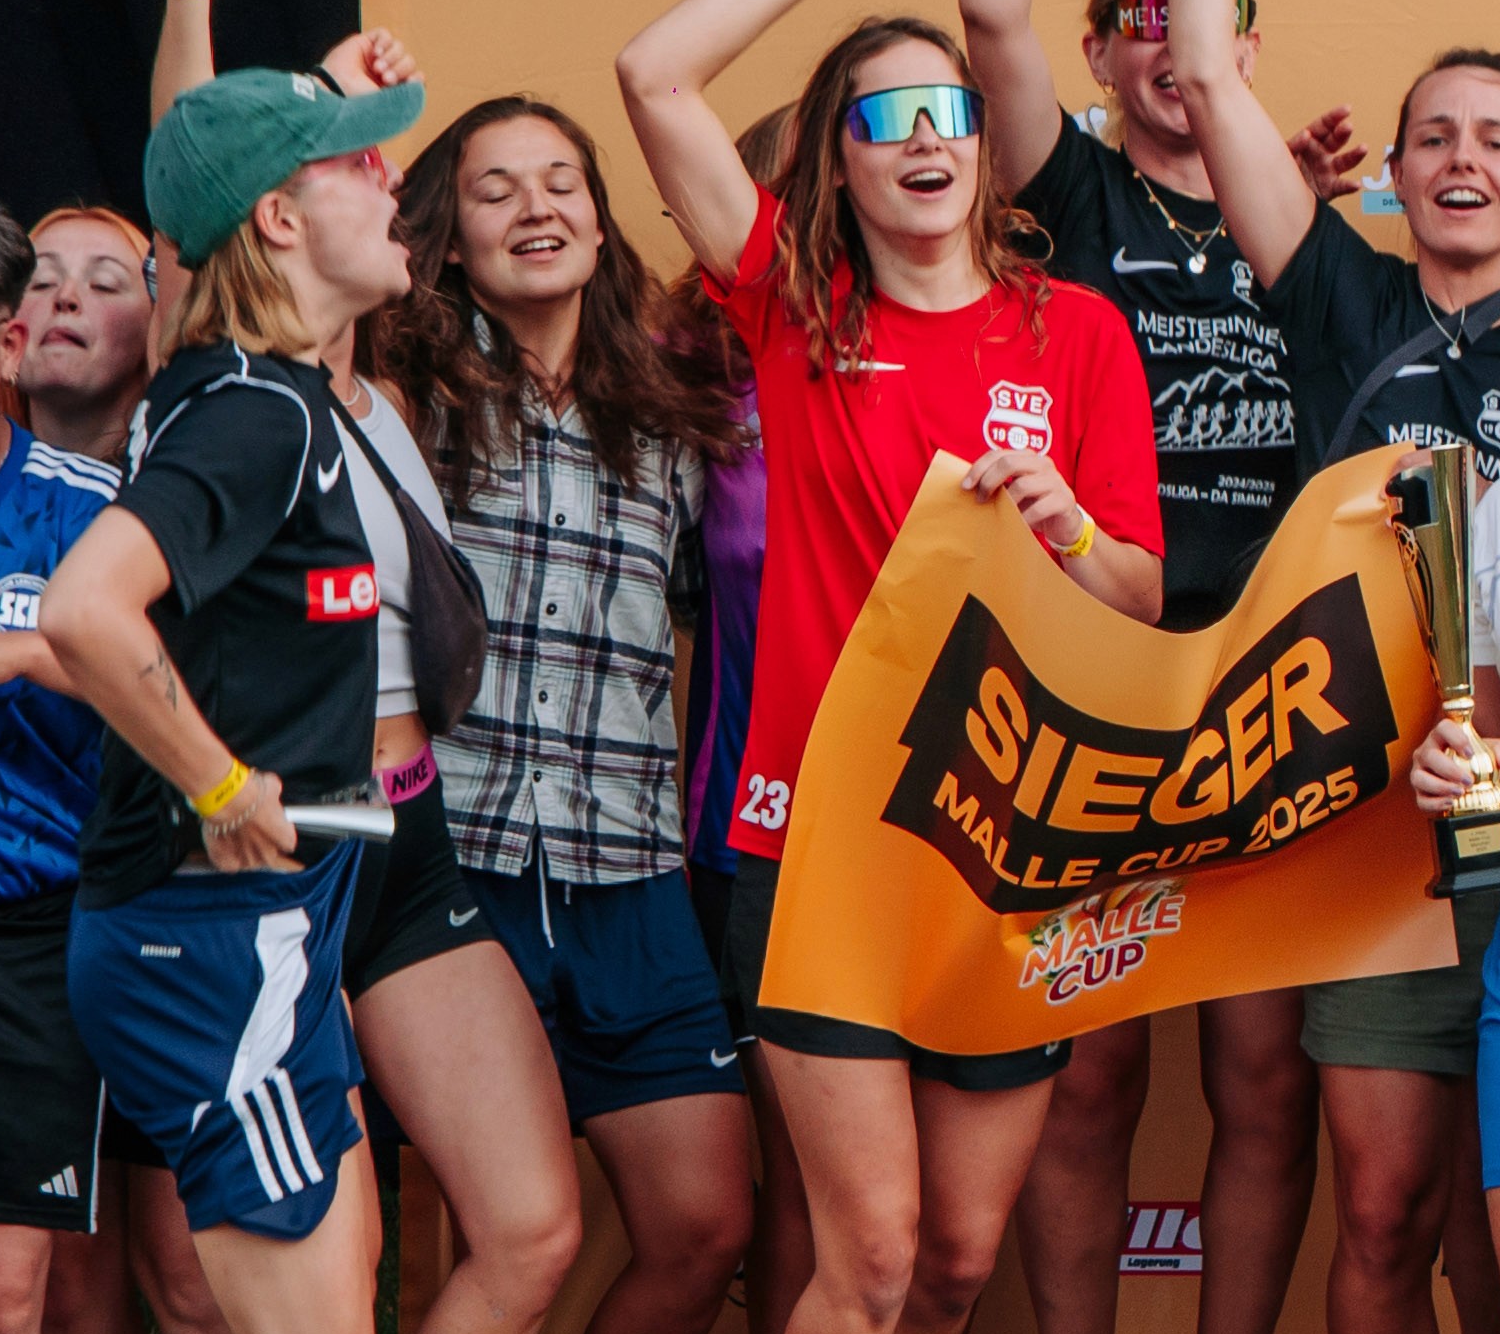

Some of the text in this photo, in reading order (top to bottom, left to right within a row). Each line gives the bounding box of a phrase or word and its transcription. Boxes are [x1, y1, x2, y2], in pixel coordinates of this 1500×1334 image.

[1148, 336, 1278, 371] LANDESLIGA
[997, 389, 1045, 412] SVE
[992, 428, 1006, 442] 19
[1211, 488, 1229, 505] DA
[965, 637, 1351, 834] SIEGER
[390, 757, 430, 796] NIKE
[739, 772, 791, 831] 23
[931, 767, 1359, 889] MALLE CUP 2025
[1019, 893, 1186, 989] MALLE
[1047, 940, 1146, 1004] CUP
[1126, 1257, 1181, 1269] Lagerung
